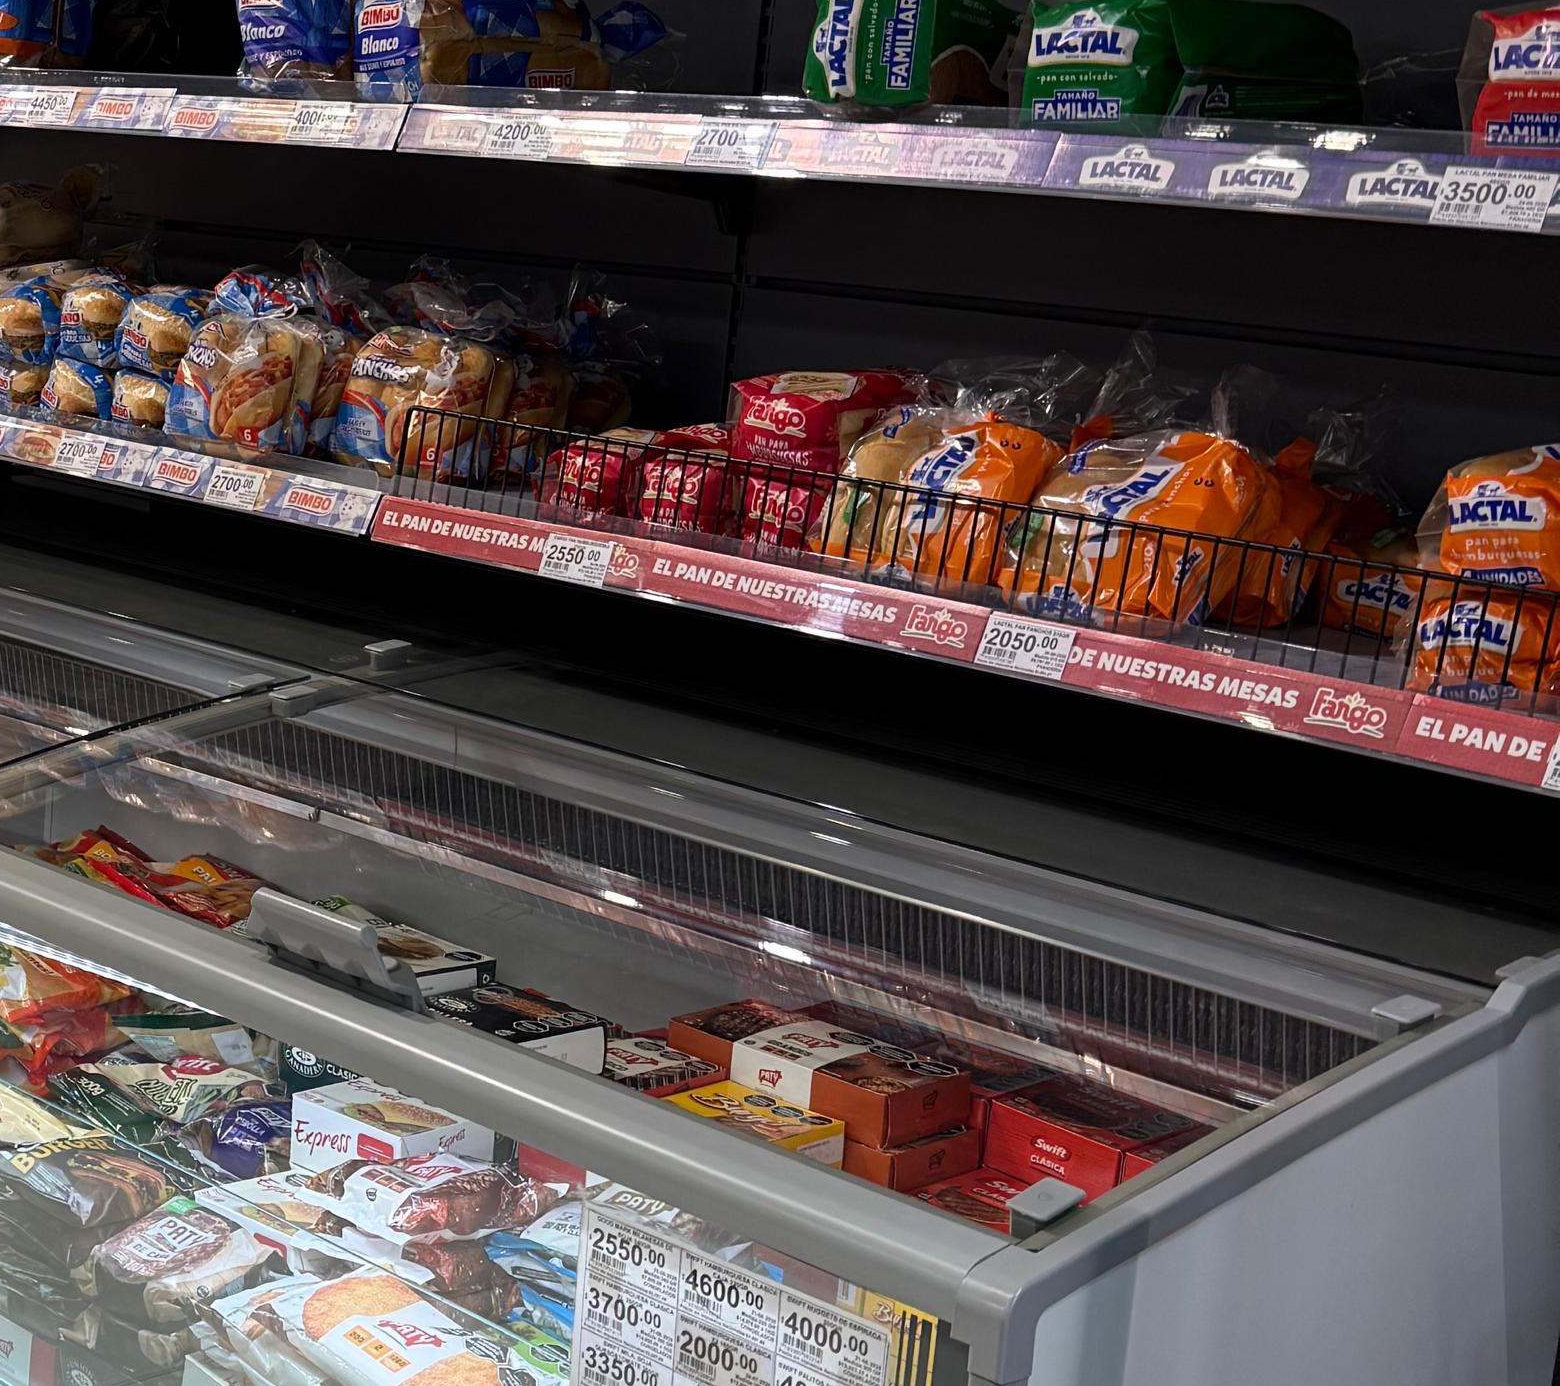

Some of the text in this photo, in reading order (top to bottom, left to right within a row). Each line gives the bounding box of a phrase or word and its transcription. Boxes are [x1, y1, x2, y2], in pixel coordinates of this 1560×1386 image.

[360, 5, 400, 27] BIMBO
[240, 23, 285, 42] Blanco
[883, 20, 893, 63] TAMAÑO
[1035, 31, 1125, 56] LACTAL
[361, 35, 399, 54] Blanco
[528, 73, 573, 89] BIMBO
[1057, 91, 1095, 100] TAMAÑO
[96, 102, 133, 115] BIMBO
[174, 112, 216, 125] BIMBO
[1035, 103, 1118, 119] FAMILIAR
[1514, 113, 1557, 123] TAMAÑO
[1090, 161, 1161, 182] LACTAL
[1219, 169, 1297, 192] LACTAL
[1358, 178, 1440, 201] LACTAL
[746, 396, 806, 433] Fargo
[243, 430, 252, 442] 6
[158, 463, 198, 483] BIMBO
[288, 491, 332, 512] BIMBO
[1449, 500, 1537, 525] LACTAL
[383, 511, 402, 527] EL
[403, 514, 429, 531] PAN
[431, 519, 450, 535] DE
[452, 522, 531, 551] NUESTRAS
[1465, 536, 1518, 550] pan para
[653, 559, 672, 577] EL
[674, 563, 710, 586] PAN
[712, 569, 738, 591] DE
[740, 573, 830, 609] NUESTRAS
[828, 596, 898, 623] MESAS
[902, 606, 969, 646] Fargo
[1070, 647, 1298, 709] DE NUESTRAS MESAS
[1310, 688, 1387, 737] Fargo
[1416, 717, 1546, 763] EL PAN DE
[760, 1070, 781, 1081] PATY
[294, 1119, 352, 1158] Express
[1035, 1138, 1067, 1158] Swift
[615, 1192, 669, 1216] PATY
[160, 1218, 208, 1248] PATY
